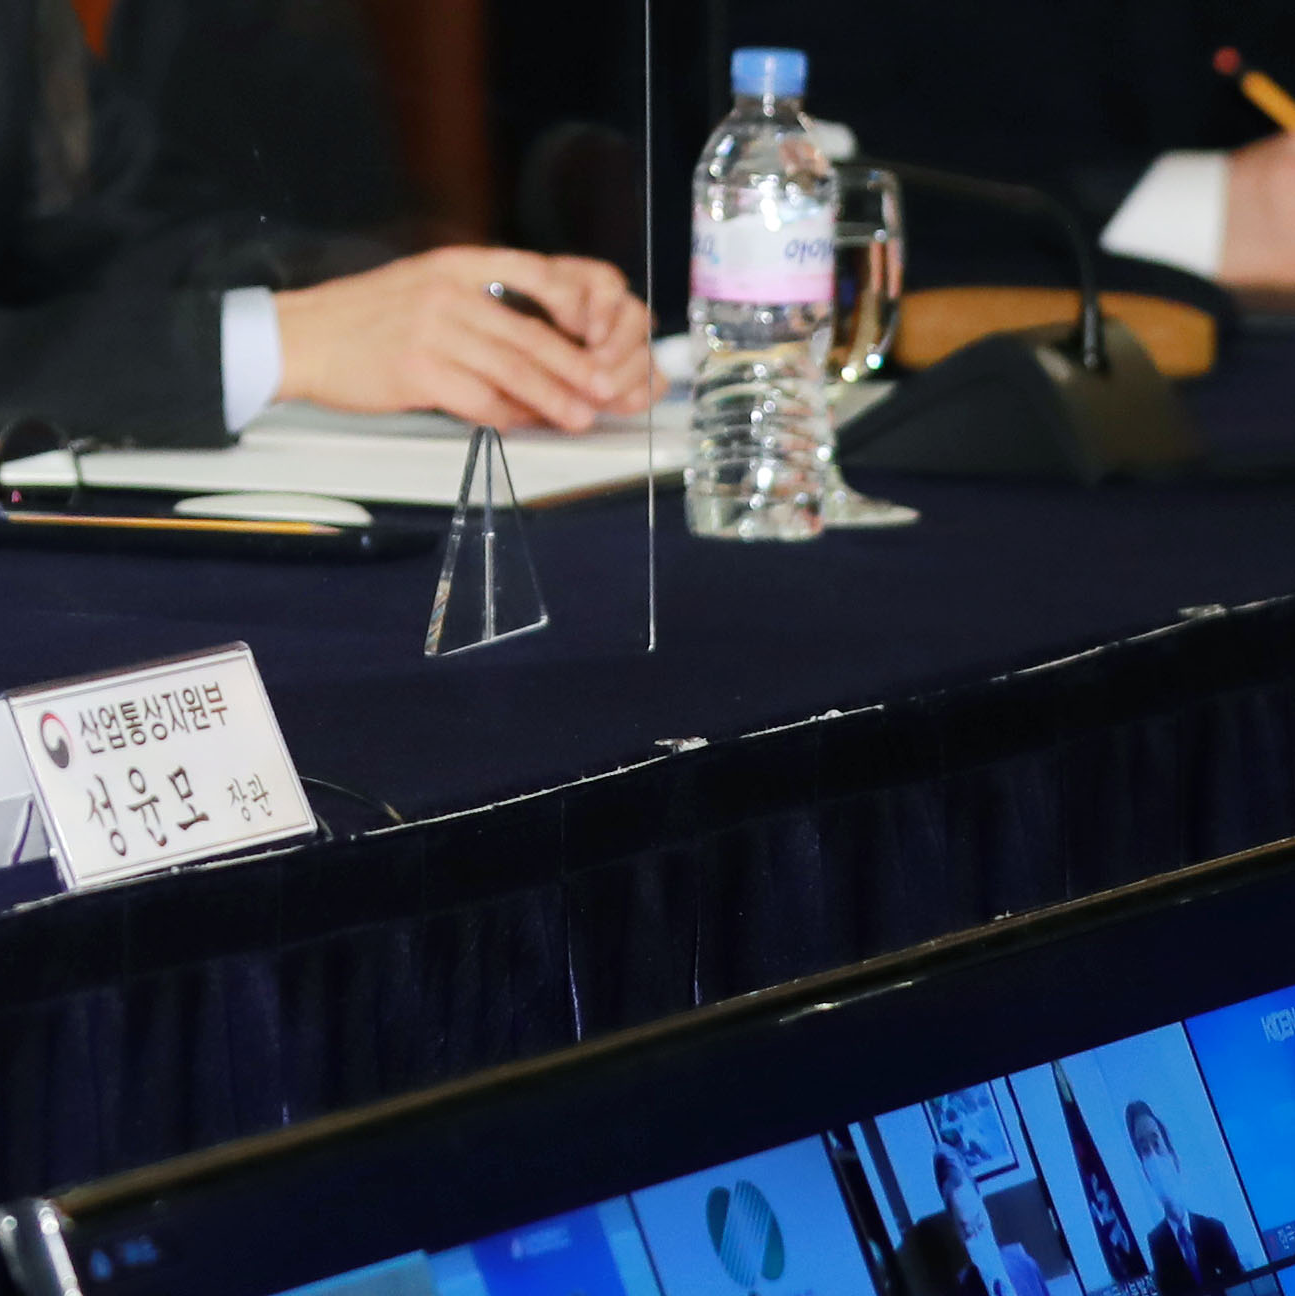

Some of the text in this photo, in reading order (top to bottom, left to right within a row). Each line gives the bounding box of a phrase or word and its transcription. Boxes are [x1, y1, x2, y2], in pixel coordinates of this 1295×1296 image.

[78, 681, 228, 755] 산업통상자원부
[87, 766, 272, 857] 성윤모 장관
